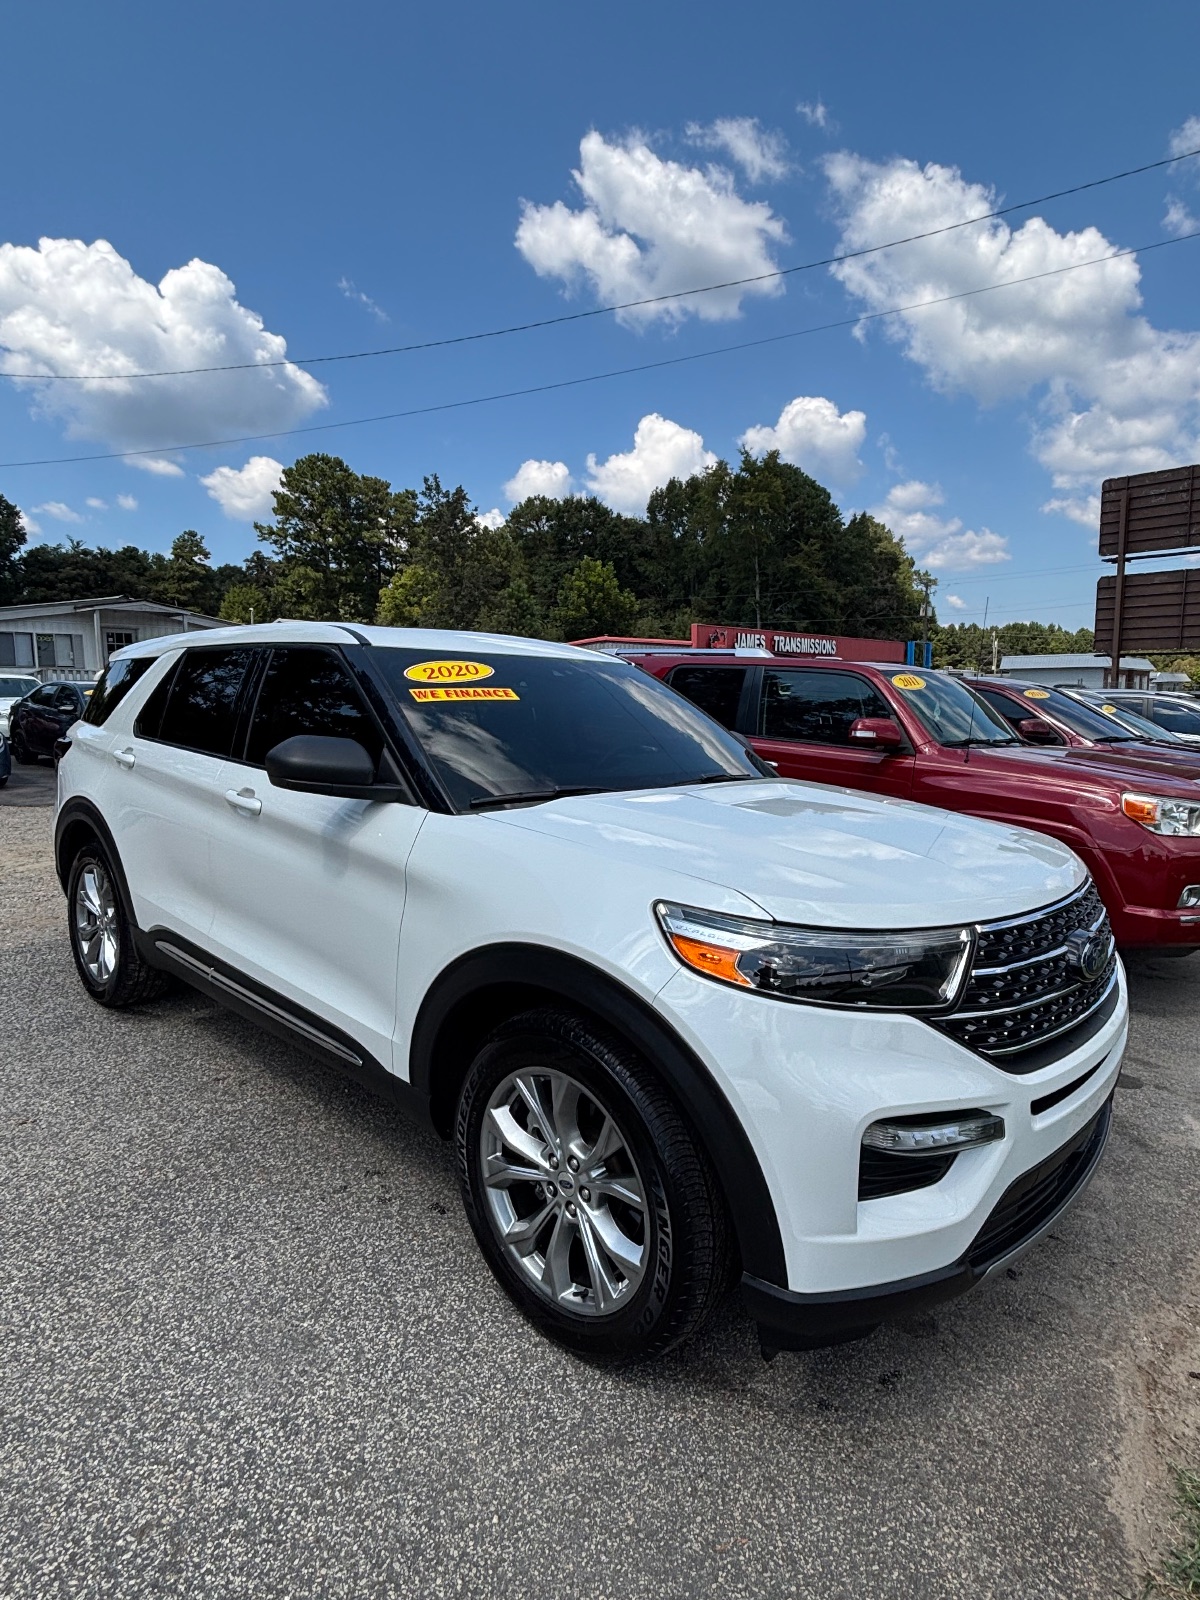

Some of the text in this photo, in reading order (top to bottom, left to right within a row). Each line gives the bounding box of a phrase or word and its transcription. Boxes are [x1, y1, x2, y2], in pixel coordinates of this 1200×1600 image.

[734, 632, 837, 655] JAMES TRANSMISSIONS
[422, 664, 480, 680] 2020
[412, 689, 514, 700] WE FINANCE
